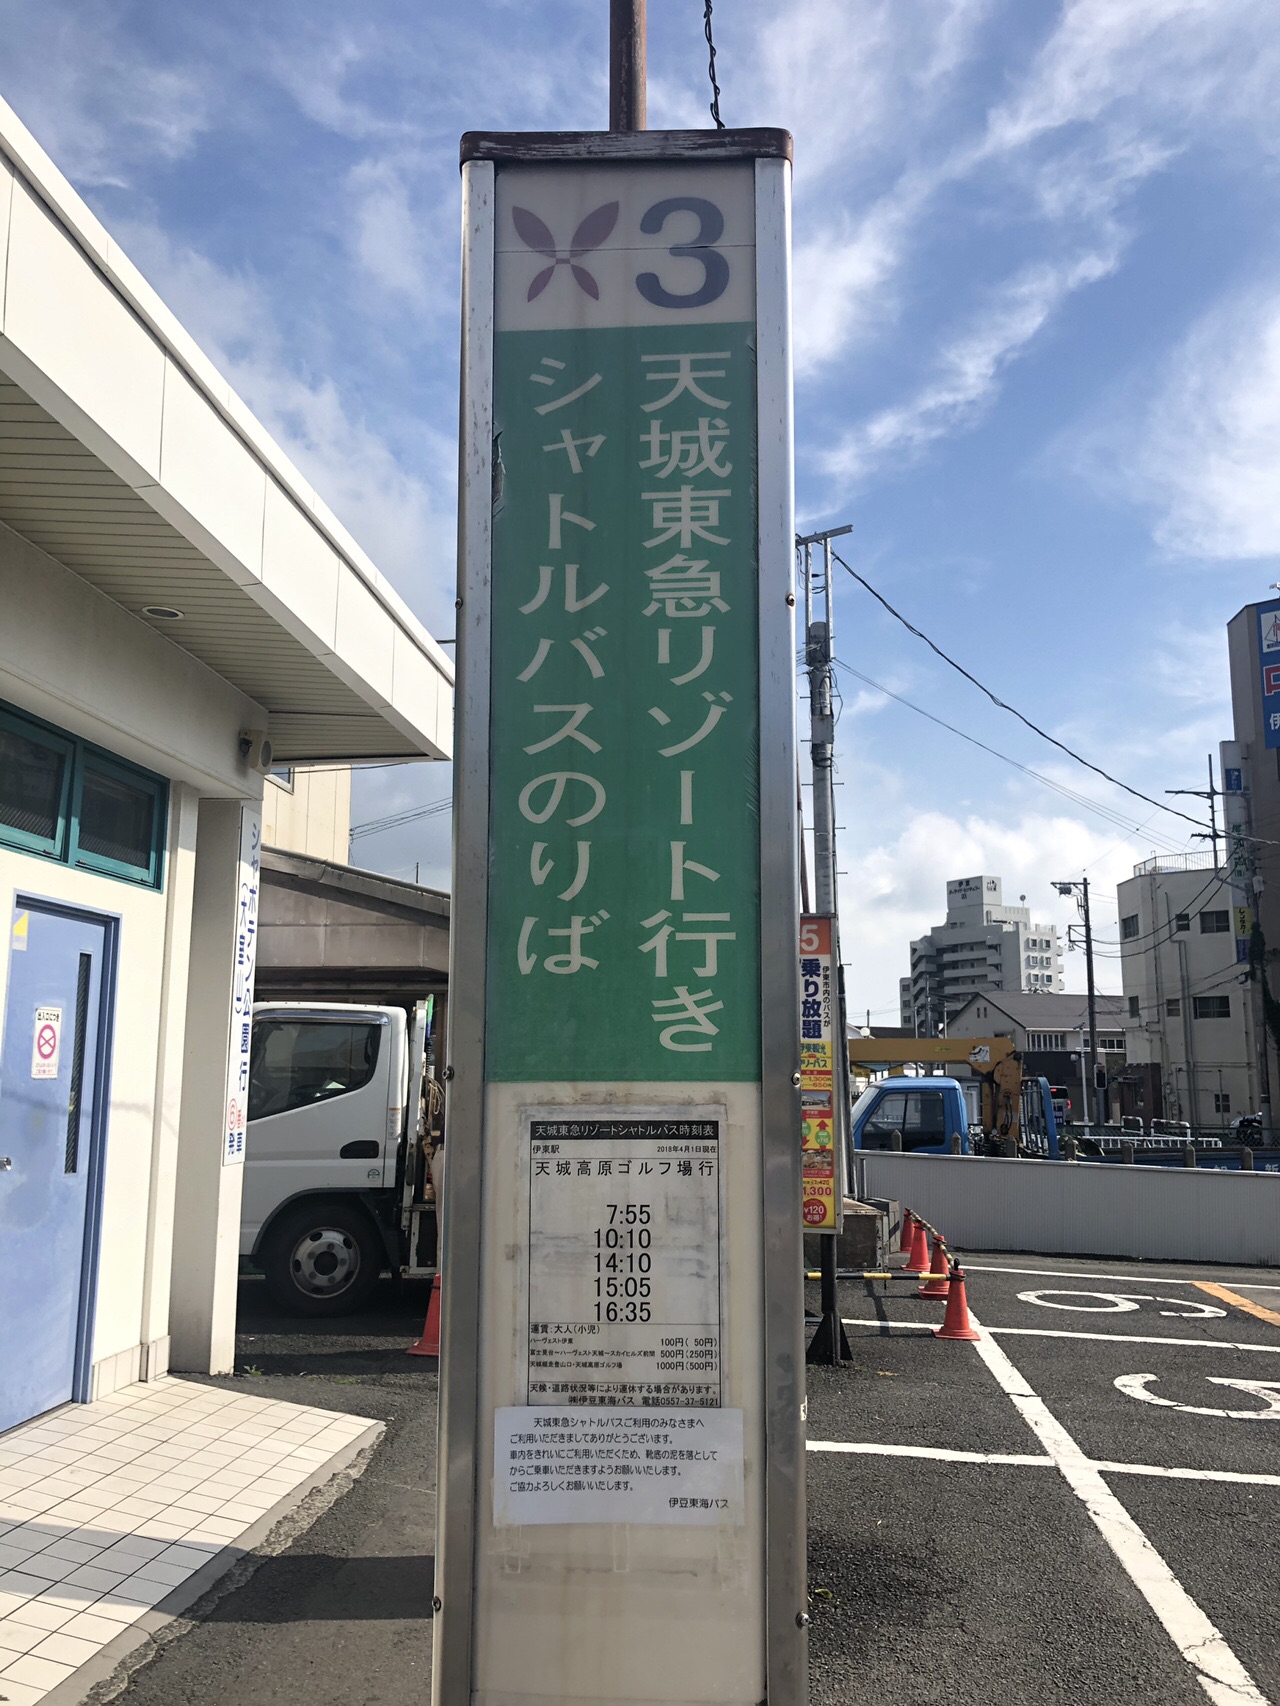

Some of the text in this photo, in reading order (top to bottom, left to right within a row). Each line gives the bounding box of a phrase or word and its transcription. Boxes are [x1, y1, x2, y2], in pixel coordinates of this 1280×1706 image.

[635, 197, 730, 308] 3
[516, 357, 610, 976] シャトルバスのりば
[639, 352, 736, 1053] 天城東急リゾート行き
[801, 924, 820, 951] 5
[239, 822, 261, 1092] シャボテン公園行
[801, 958, 823, 1040] 乗り放題
[822, 965, 831, 1028] 伊東市内のバスが
[535, 1124, 714, 1136] 天城東急リゾートシャトルバス時刻表
[532, 1144, 717, 1154] 伊東駅 2018年4月1日現在
[535, 1160, 715, 1176] 天城高原ゴルフ場行
[606, 1204, 651, 1225] 7:55
[594, 1228, 651, 1249] 10:10
[594, 1252, 651, 1273] 14:10
[594, 1277, 651, 1298] 15:05
[594, 1301, 651, 1322] 16:35
[530, 1324, 601, 1334] 運賃:大人(小児)
[660, 1350, 718, 1360] 500円(250円)
[656, 1361, 718, 1371] 1000円(500円)
[534, 1417, 705, 1428] 天城東急シャトルバスご利用のみなさまへ
[510, 1433, 673, 1444] ご利用いただきましてありがとうございます。
[510, 1449, 718, 1460] 車内をきれいにご利用いただくため、靴底の泥を落として
[510, 1464, 682, 1476] からご乗車いただきますようお願いいたします。
[510, 1481, 633, 1492] ご協力よろしくお願いいたします。
[669, 1497, 729, 1509] 伊豆東海バス
